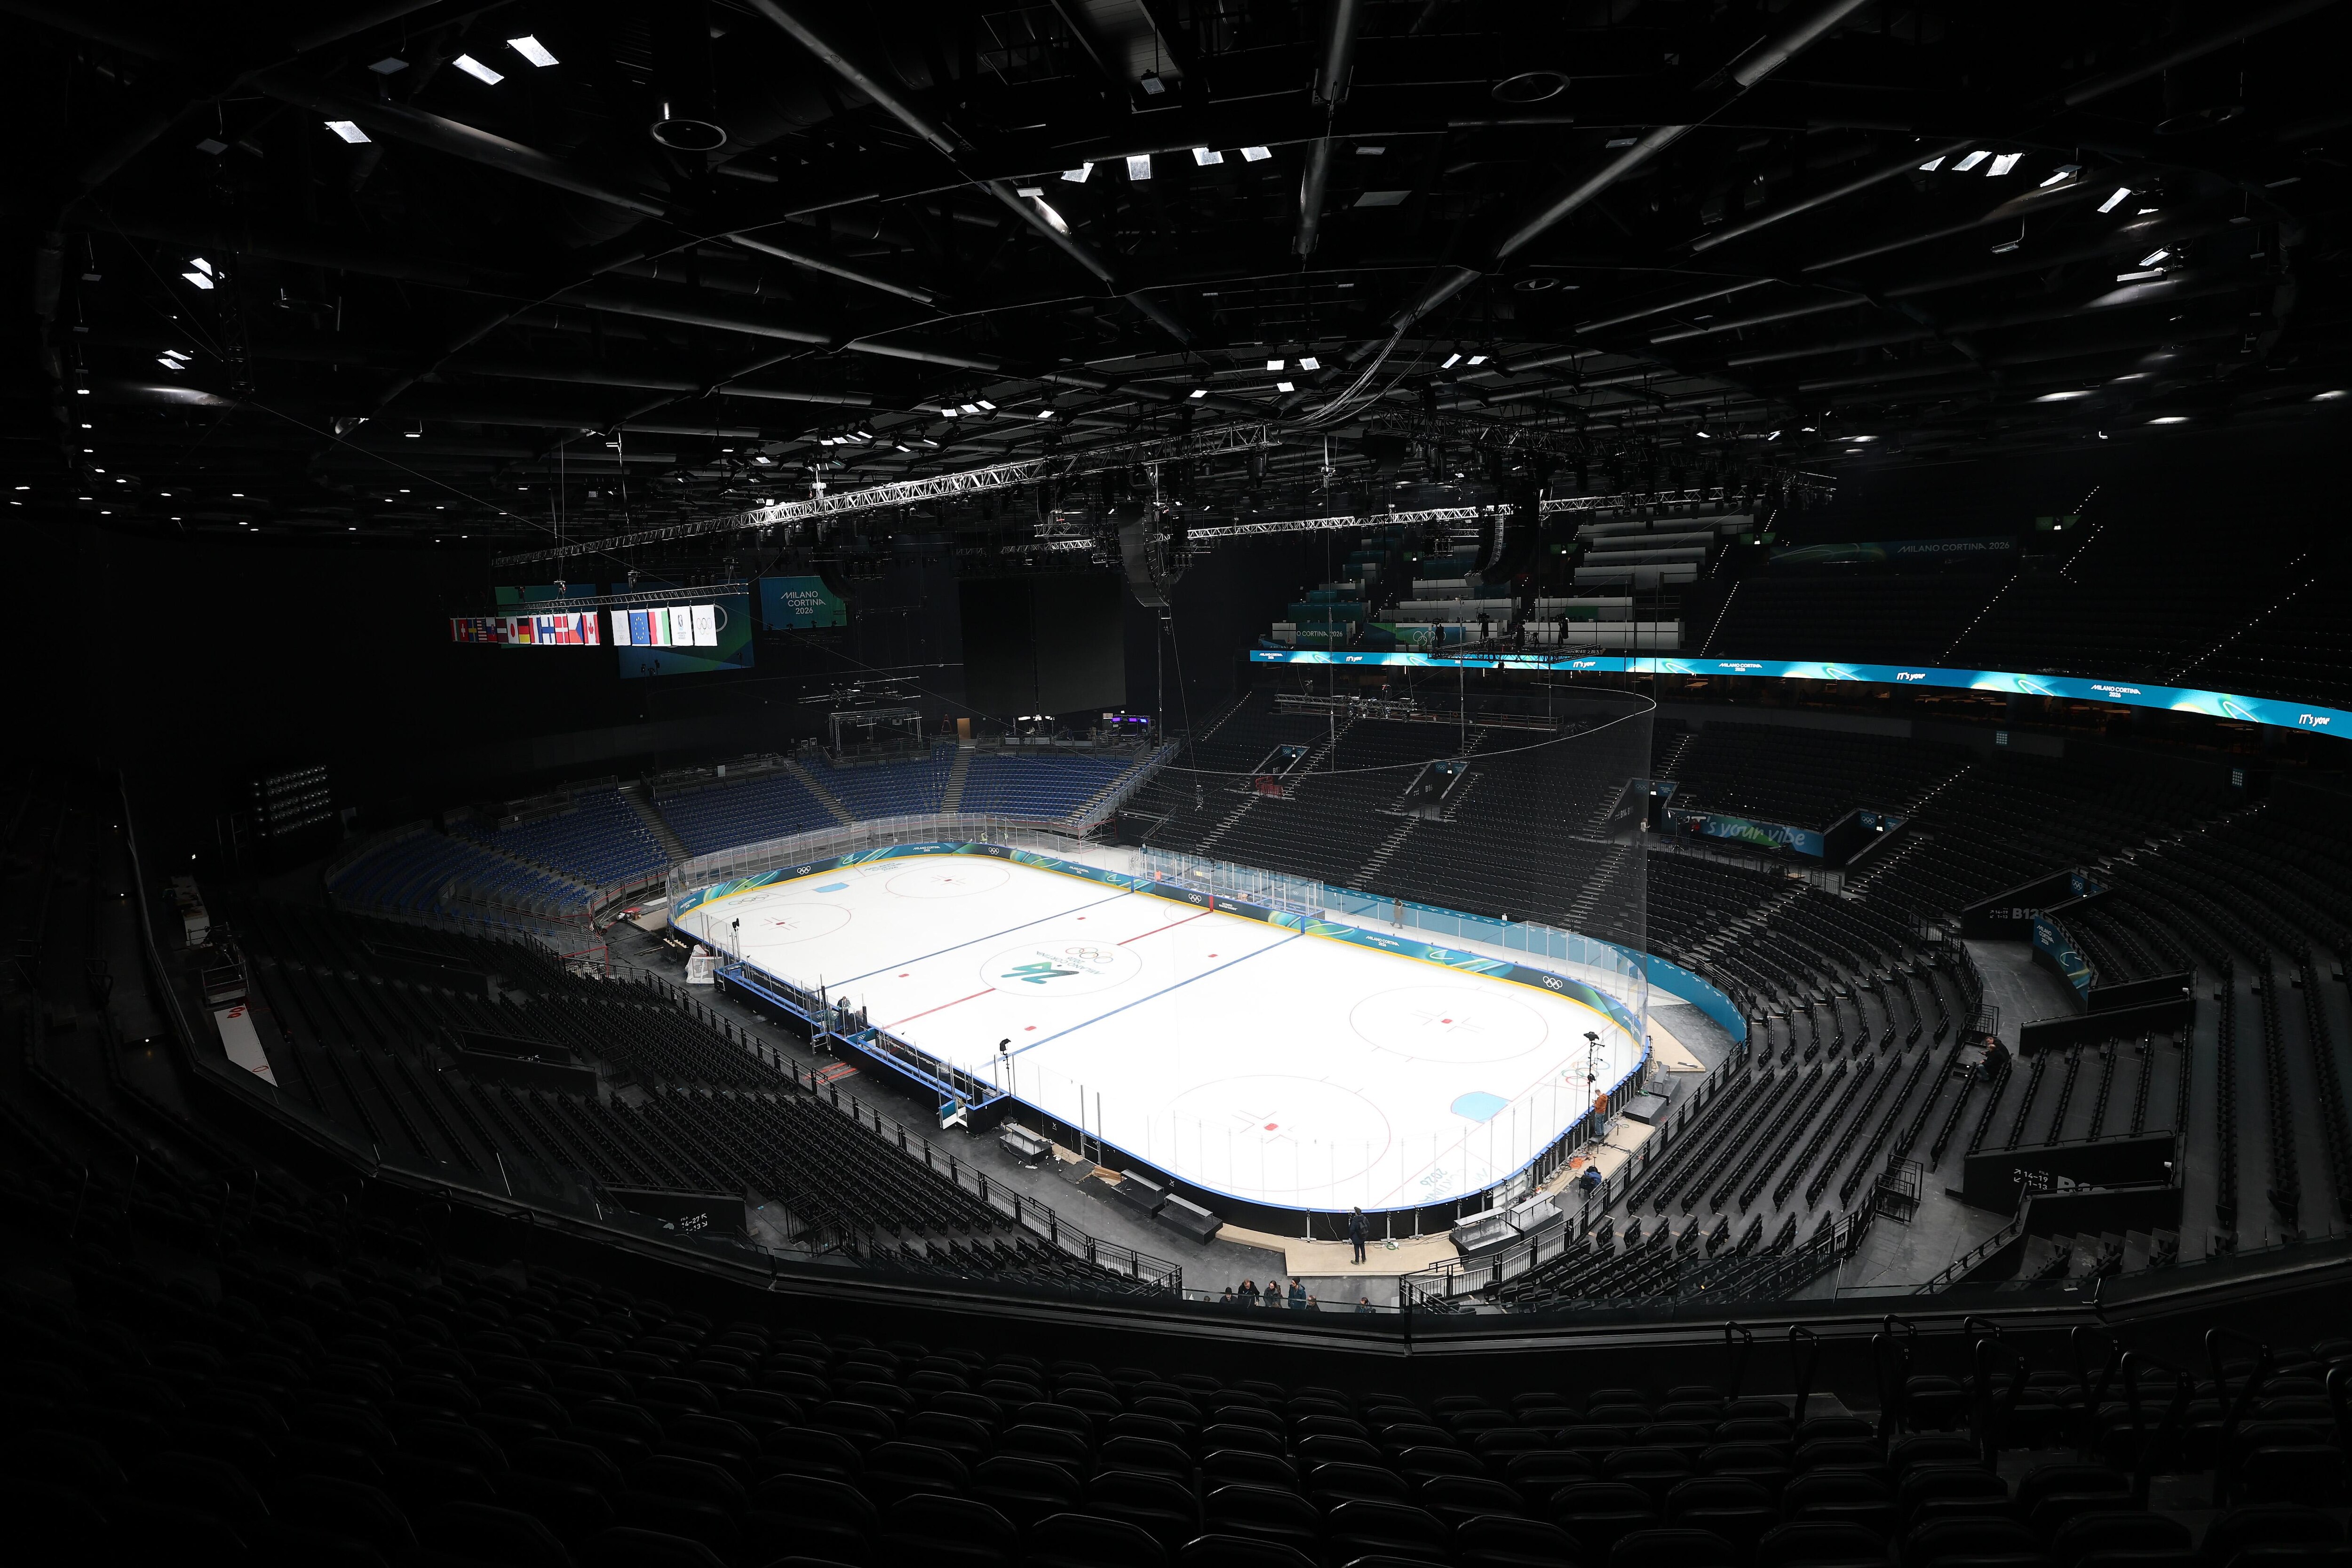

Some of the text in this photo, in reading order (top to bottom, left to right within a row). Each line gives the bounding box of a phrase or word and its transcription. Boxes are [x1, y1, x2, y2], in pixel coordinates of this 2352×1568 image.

[1897, 544, 1940, 553] MILANO
[780, 590, 818, 599] MILANO
[787, 598, 826, 607] CORTINA
[2299, 714, 2330, 727] IT's your
[1719, 823, 1764, 840] your
[1768, 827, 1805, 846] vibe
[2012, 907, 2039, 919] B12
[2037, 925, 2052, 936] MILANO
[2039, 931, 2054, 943] CORTINA
[1420, 1168, 1448, 1187] 2026
[2024, 1171, 2048, 1183] 14-19
[2028, 1180, 2048, 1190] 1-13
